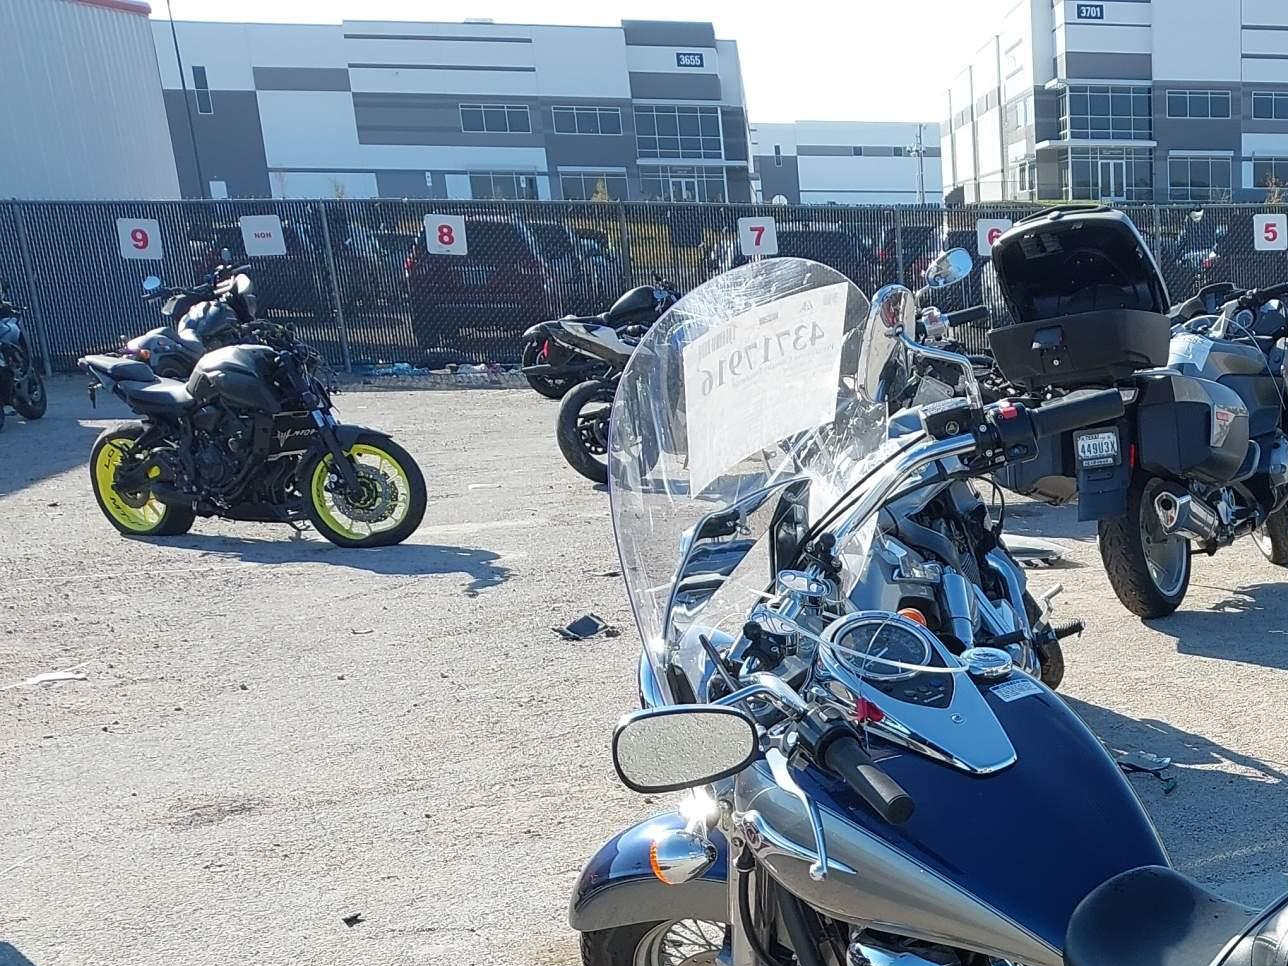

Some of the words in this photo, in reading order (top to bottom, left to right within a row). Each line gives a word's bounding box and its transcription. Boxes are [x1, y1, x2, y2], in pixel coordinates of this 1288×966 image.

[1080, 6, 1101, 17] 3701
[679, 54, 701, 66] 3655
[130, 228, 149, 250] 9
[438, 224, 455, 246] 8
[749, 226, 765, 246] 7
[1263, 222, 1278, 242] 5
